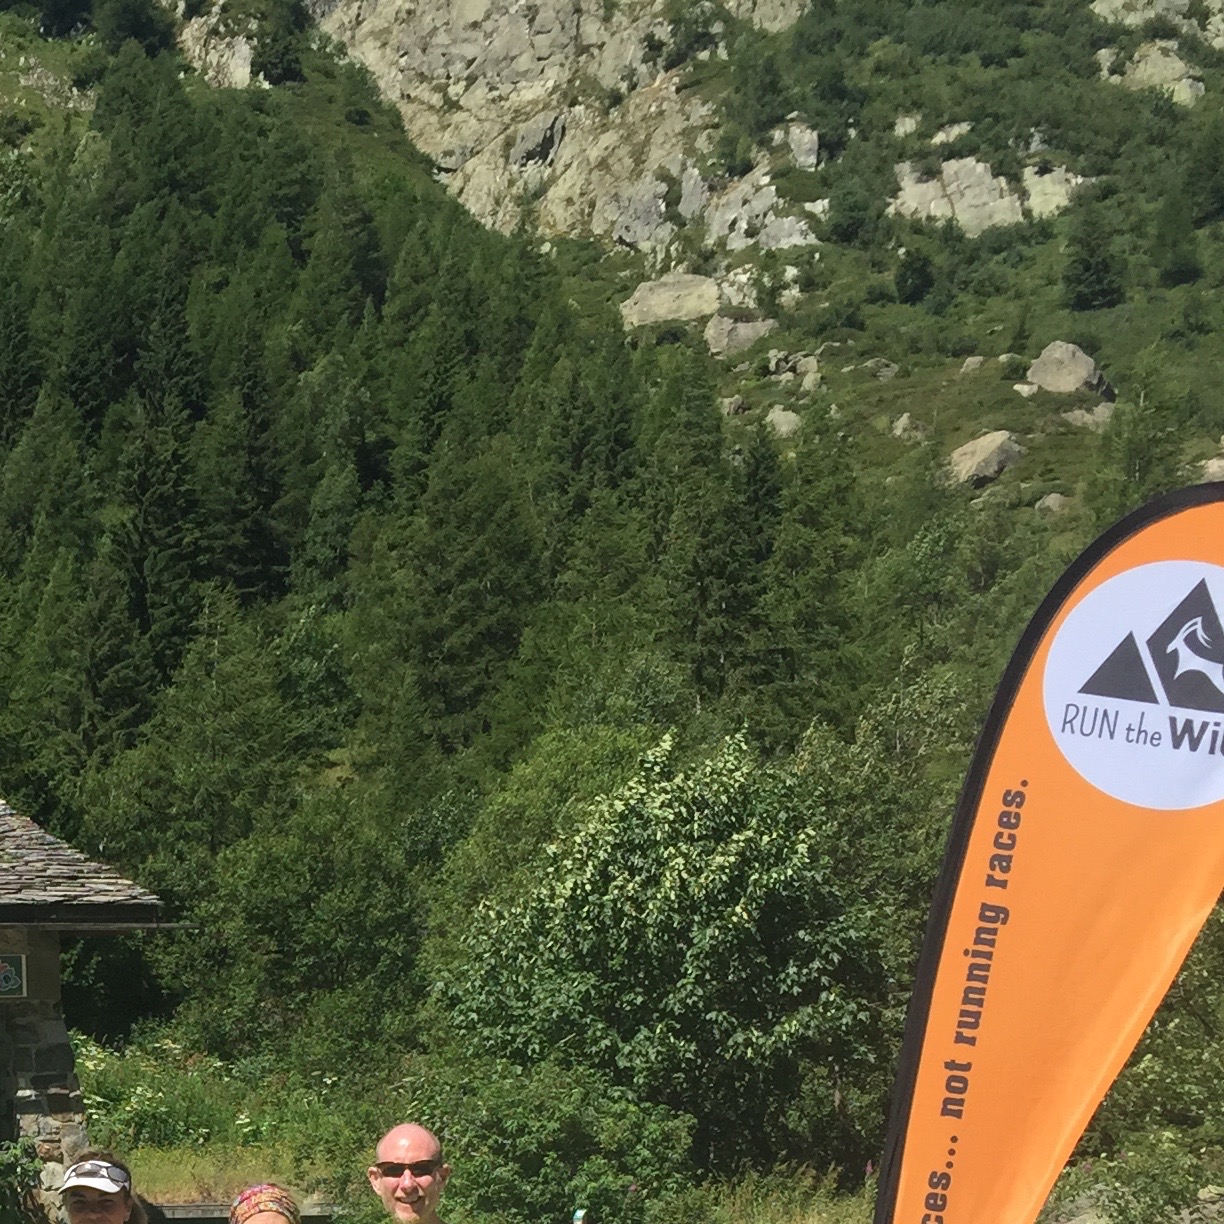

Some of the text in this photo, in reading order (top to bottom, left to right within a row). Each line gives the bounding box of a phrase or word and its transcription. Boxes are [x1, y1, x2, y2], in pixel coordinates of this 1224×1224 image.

[1061, 703, 1224, 757] RUN the Wi
[985, 779, 1029, 890] races.
[954, 901, 1010, 1047] running
[940, 1059, 973, 1120] not
